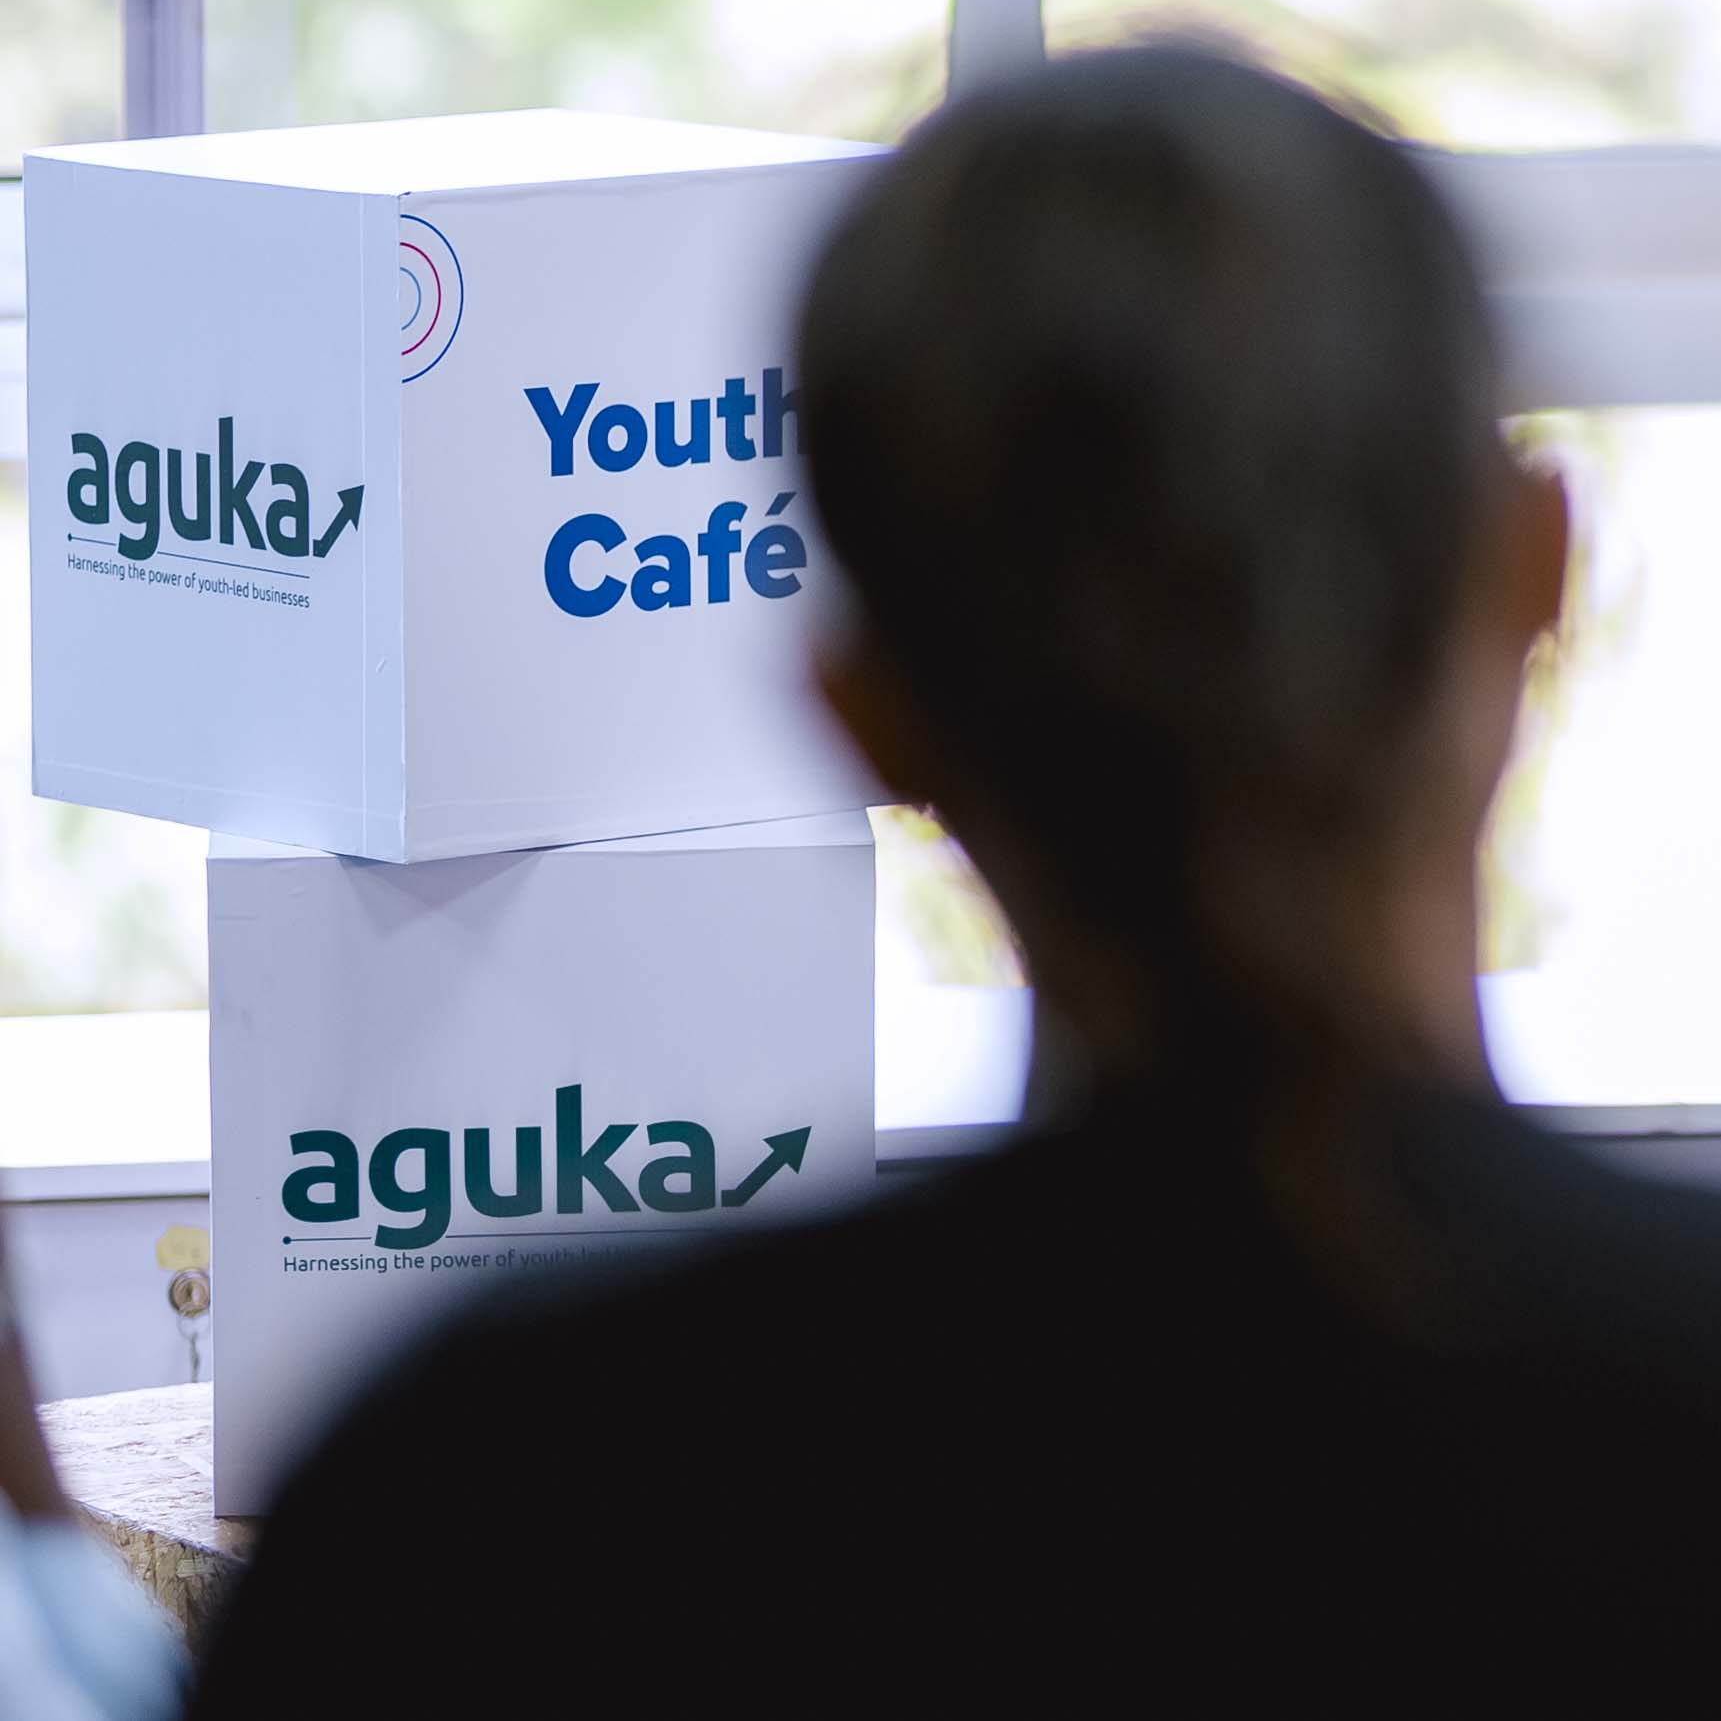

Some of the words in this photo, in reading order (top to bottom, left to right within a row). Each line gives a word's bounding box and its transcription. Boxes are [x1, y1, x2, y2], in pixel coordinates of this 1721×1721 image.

[523, 367, 810, 477] Youth
[67, 416, 310, 561] aguka
[67, 552, 126, 581] Harnessing
[128, 562, 146, 580] the
[148, 569, 182, 587] power
[184, 572, 198, 588] of
[198, 576, 250, 598] youth-led
[252, 586, 311, 608] businesses
[544, 491, 808, 619] Café
[281, 1083, 716, 1250] aguka
[283, 1254, 388, 1274] Harnessing
[393, 1252, 425, 1270] the
[430, 1254, 490, 1274] power
[494, 1249, 515, 1268] of
